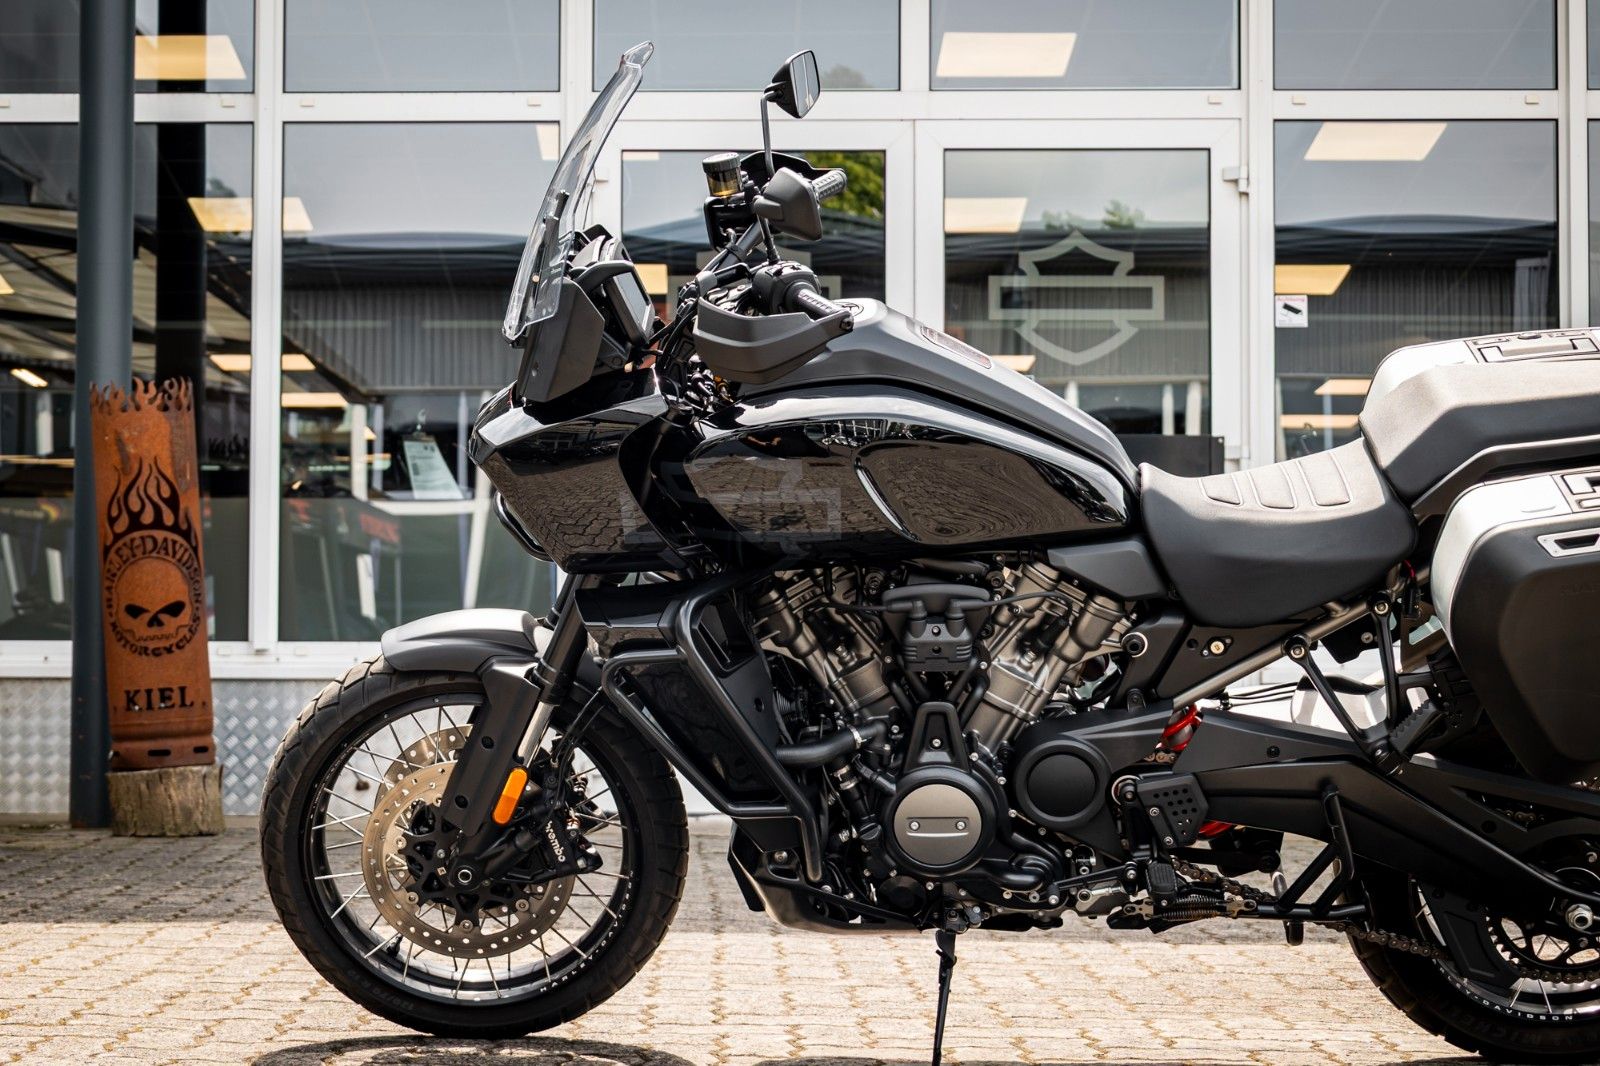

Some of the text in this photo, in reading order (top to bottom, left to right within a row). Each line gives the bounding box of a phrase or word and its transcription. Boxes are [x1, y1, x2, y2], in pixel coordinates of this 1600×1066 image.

[105, 535, 202, 609] HARLEY-DAVIDSON
[110, 614, 201, 657] MOTORCYCLES
[124, 686, 194, 712] KIEL
[545, 820, 566, 862] brembo
[540, 870, 634, 992] HARLEY-DAVIDSON
[1432, 958, 1573, 1020] ARLEY-DAVIDSON
